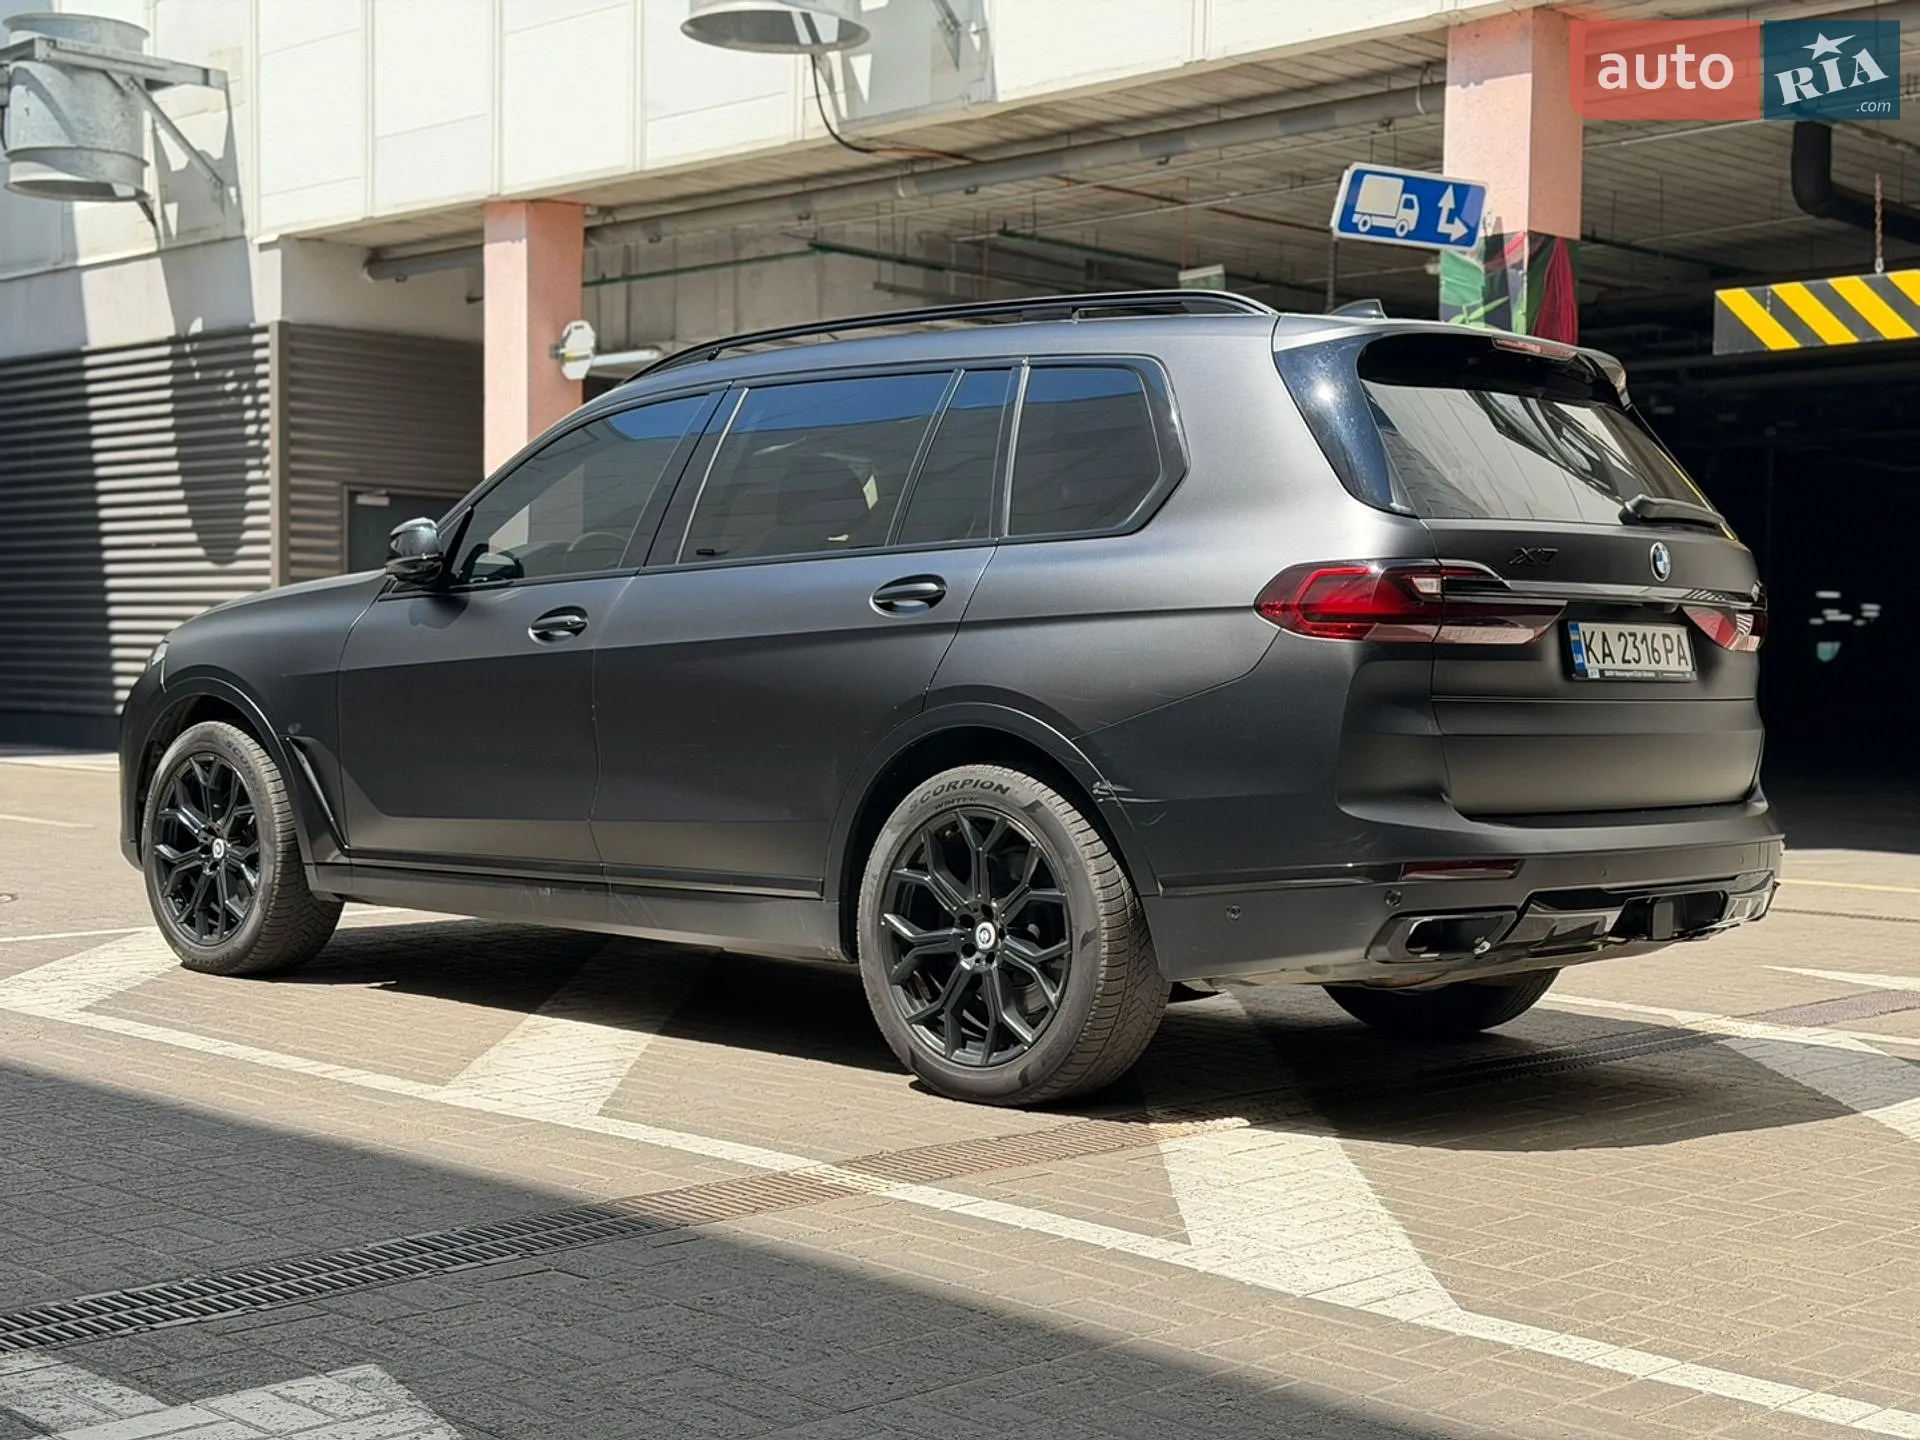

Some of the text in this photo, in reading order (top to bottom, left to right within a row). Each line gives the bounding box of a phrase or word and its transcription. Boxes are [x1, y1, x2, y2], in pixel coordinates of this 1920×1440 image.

[1509, 546, 1559, 565] X7
[1582, 631, 1688, 666] KA 2316 PA
[909, 778, 1011, 814] SCORPION
